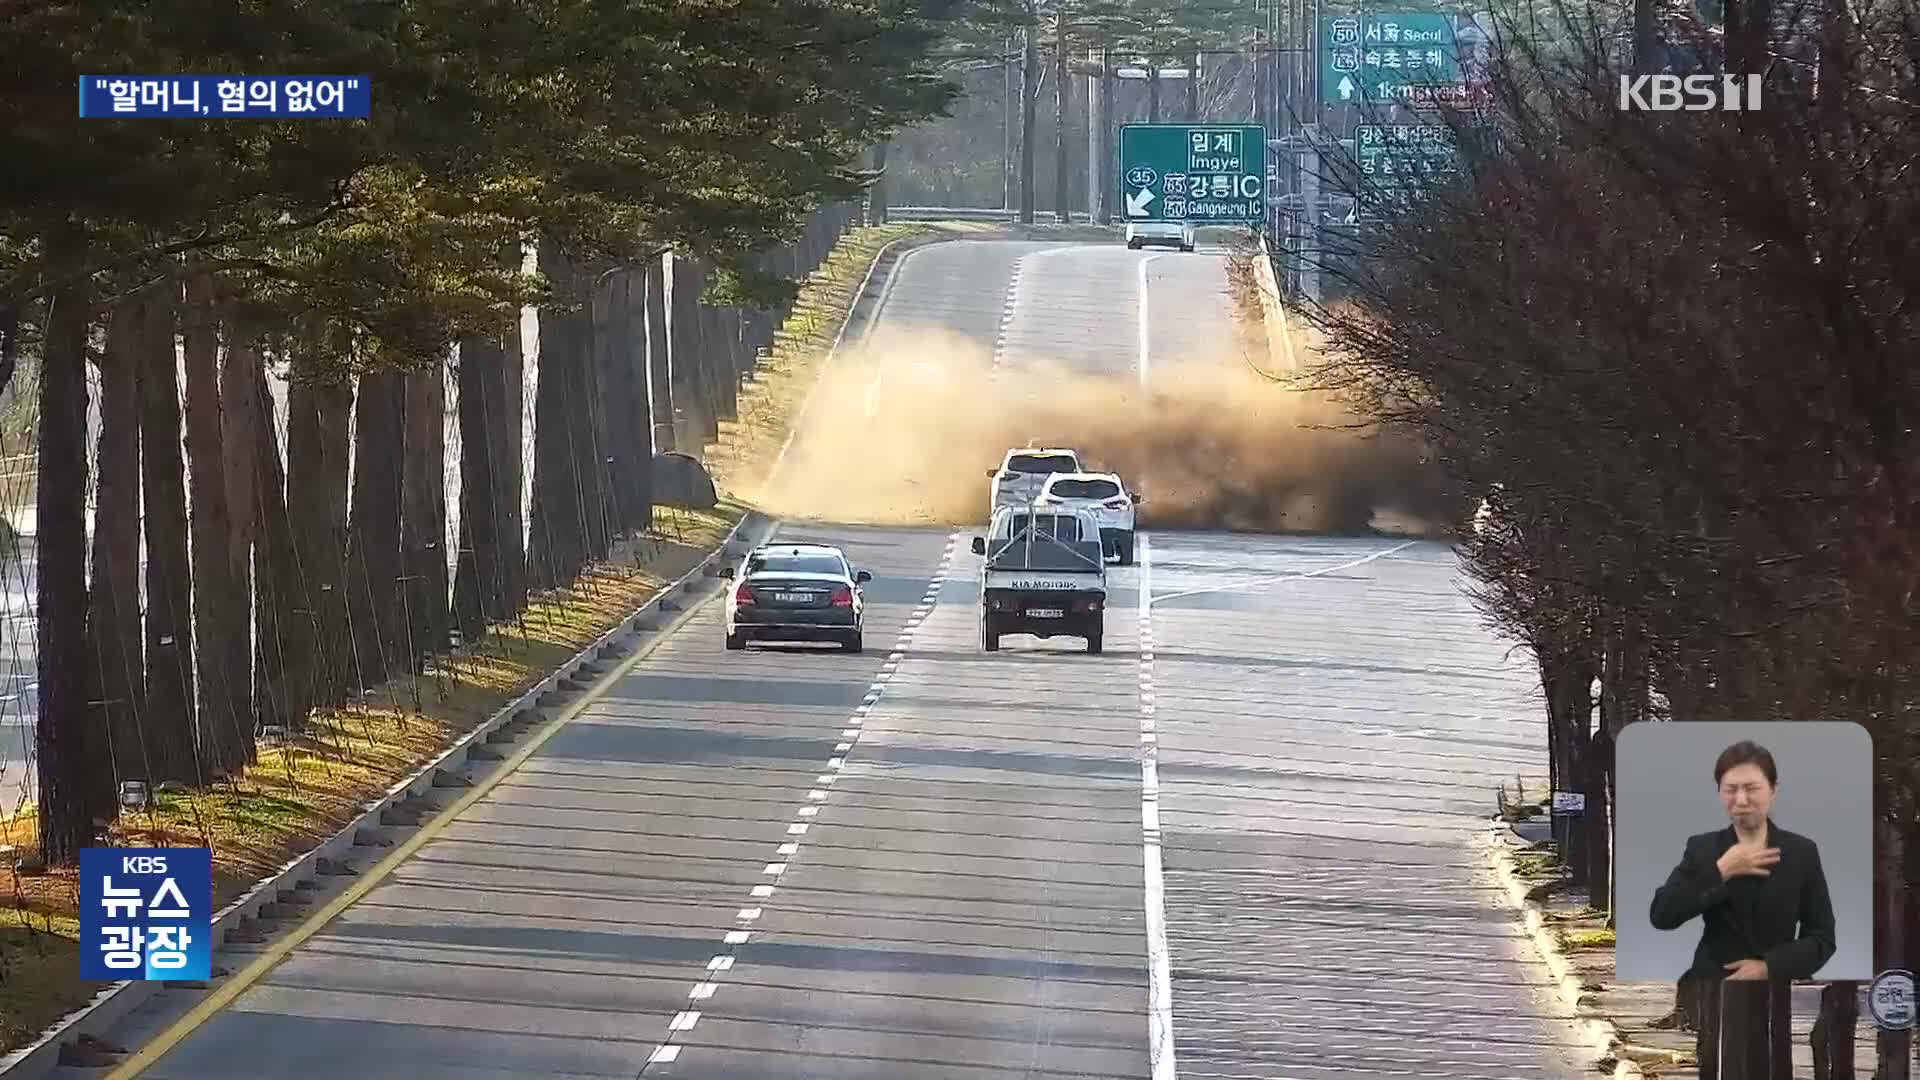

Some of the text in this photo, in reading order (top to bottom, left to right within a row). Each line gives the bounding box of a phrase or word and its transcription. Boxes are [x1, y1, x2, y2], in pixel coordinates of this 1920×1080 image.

[1336, 29, 1354, 41] 50
[1403, 29, 1441, 41] Seoul
[1191, 133, 1232, 153] 임계
[1191, 155, 1240, 173] Imgye
[1132, 171, 1151, 183] 35
[1190, 175, 1262, 199] 강릉IC
[1188, 201, 1262, 217] Gangneung IC
[1011, 580, 1030, 589] KIA
